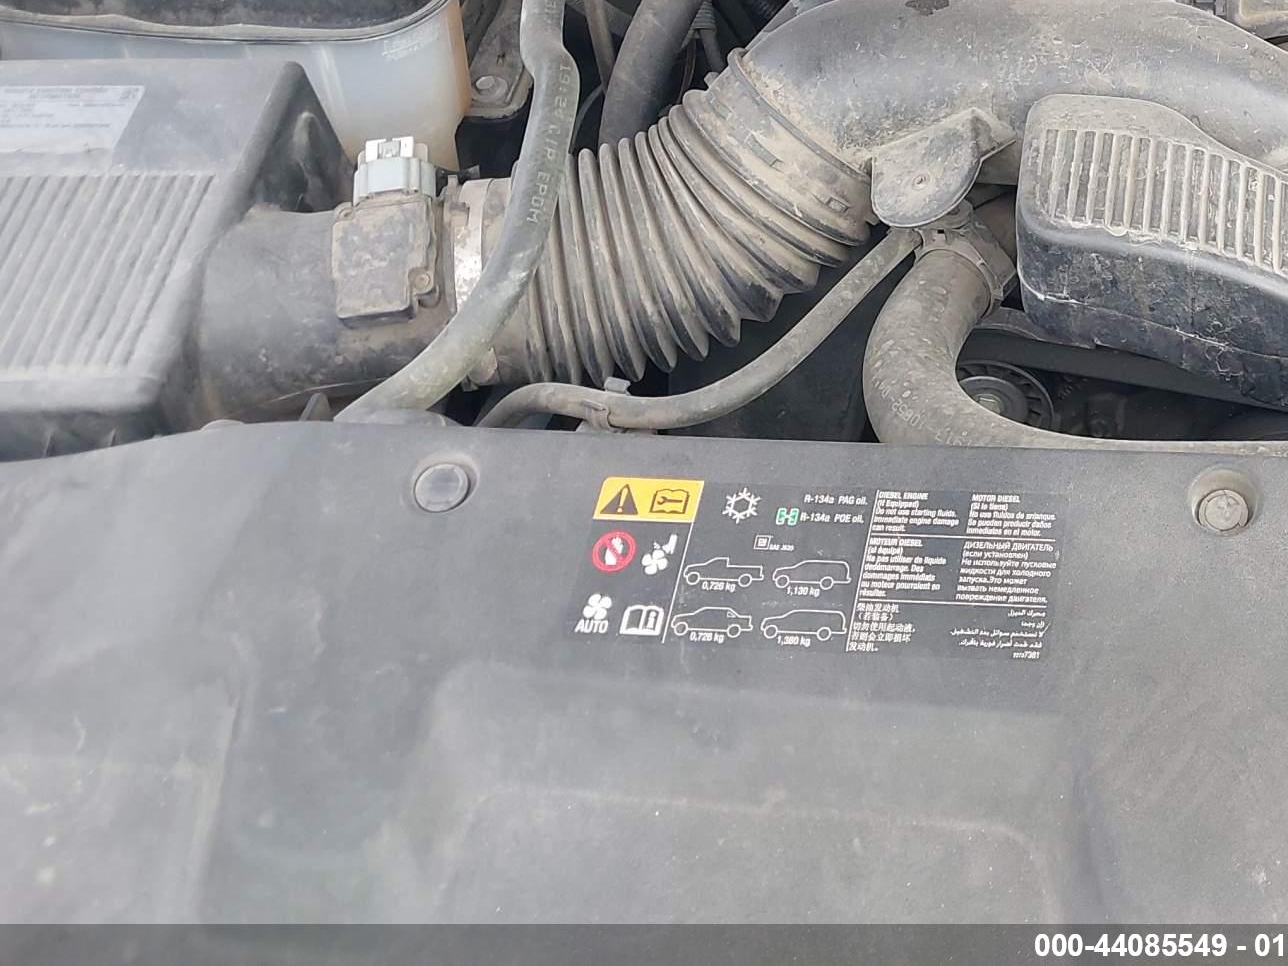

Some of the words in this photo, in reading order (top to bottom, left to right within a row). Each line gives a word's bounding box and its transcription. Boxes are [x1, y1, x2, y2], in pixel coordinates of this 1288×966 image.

[526, 171, 550, 224] EPDM
[804, 494, 834, 504] R-134a
[838, 496, 855, 504] PAG
[856, 496, 868, 505] oil.
[879, 491, 902, 500] DIESEL
[902, 492, 929, 500] ENGINE
[971, 494, 996, 502] MOTOR
[997, 494, 1020, 502] DIESEL
[885, 508, 897, 516] not
[800, 512, 830, 522] R-134a
[834, 514, 852, 523] POE
[852, 514, 864, 524] oil.
[898, 538, 924, 547] DIESEL
[963, 540, 1010, 550] ДИЗЕЛЬНЫЙ
[1011, 542, 1054, 552] ДВИГАТЕЛЬ
[725, 582, 736, 592] kg
[786, 585, 808, 596] 1,130
[808, 586, 820, 597] kg
[574, 618, 609, 634] AUTO
[714, 634, 724, 644] kg
[800, 636, 810, 647] kg
